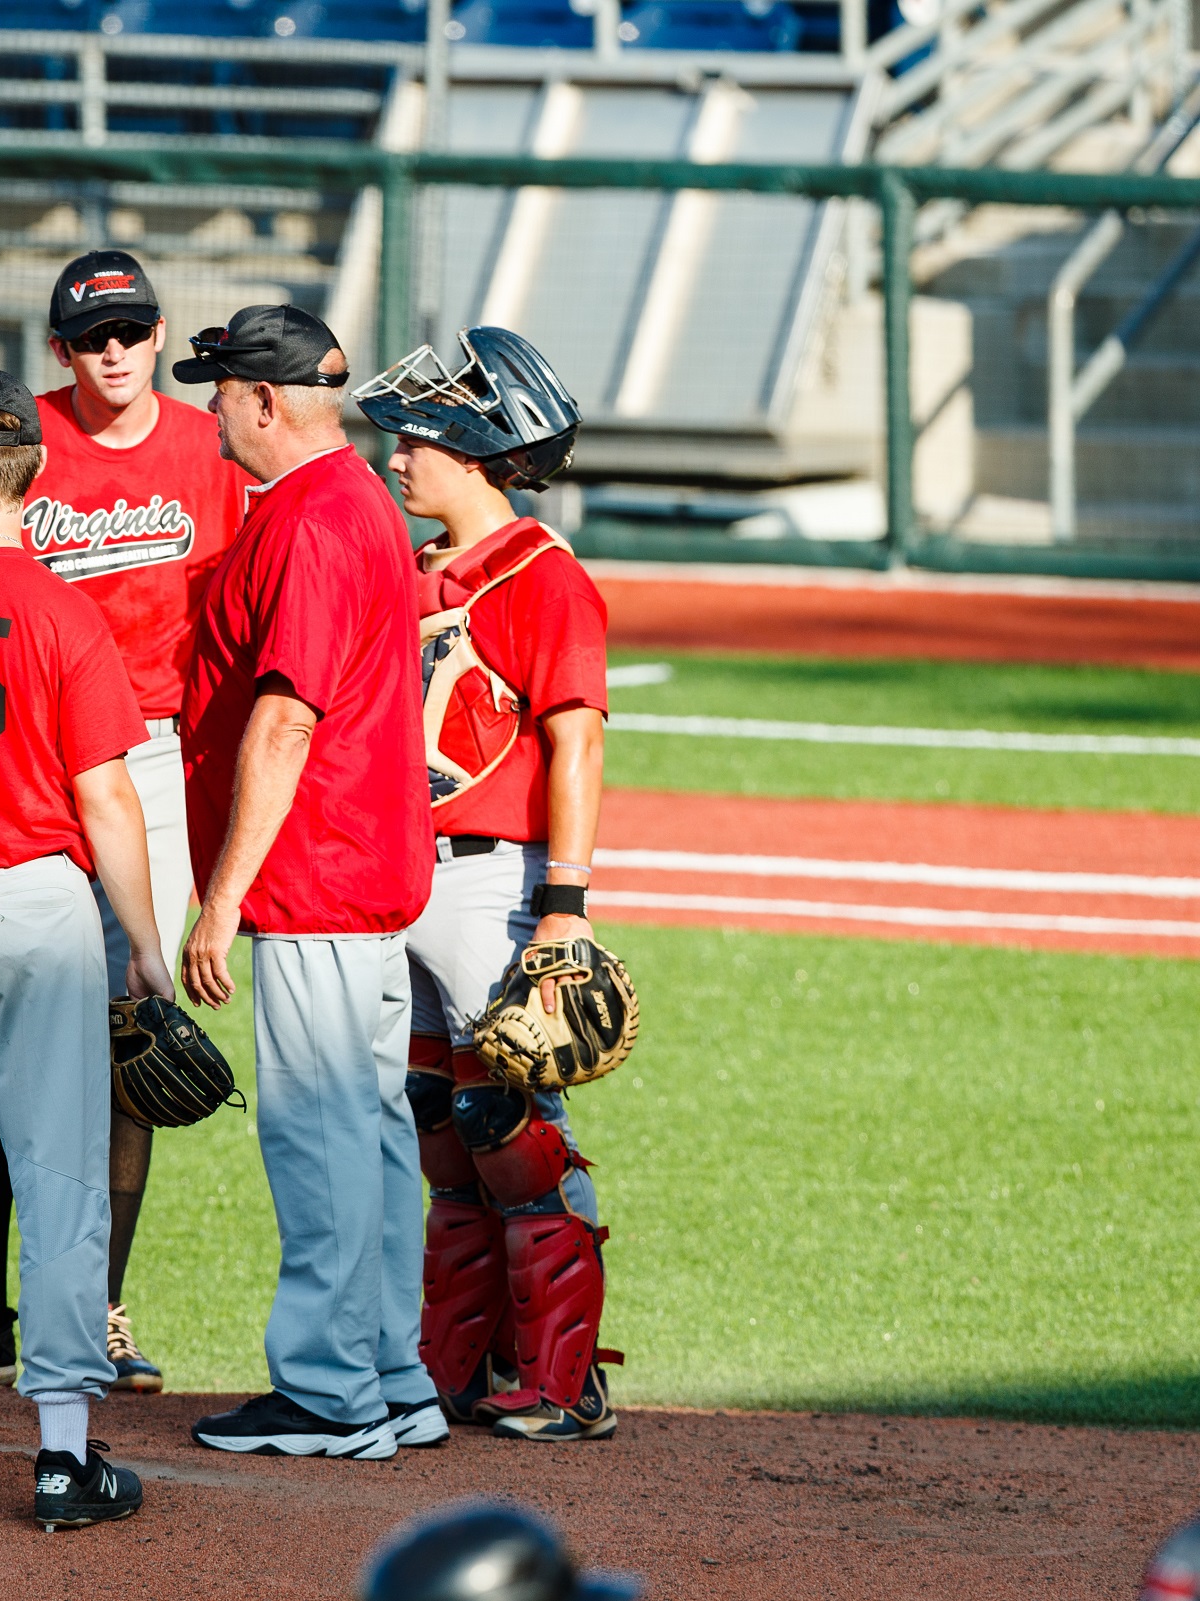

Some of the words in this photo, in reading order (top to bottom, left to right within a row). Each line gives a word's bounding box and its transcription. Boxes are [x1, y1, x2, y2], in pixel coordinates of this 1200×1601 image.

[94, 280, 130, 291] GAMES
[22, 495, 182, 551] Virginia
[148, 544, 178, 559] GAMES
[36, 1474, 71, 1494] NB
